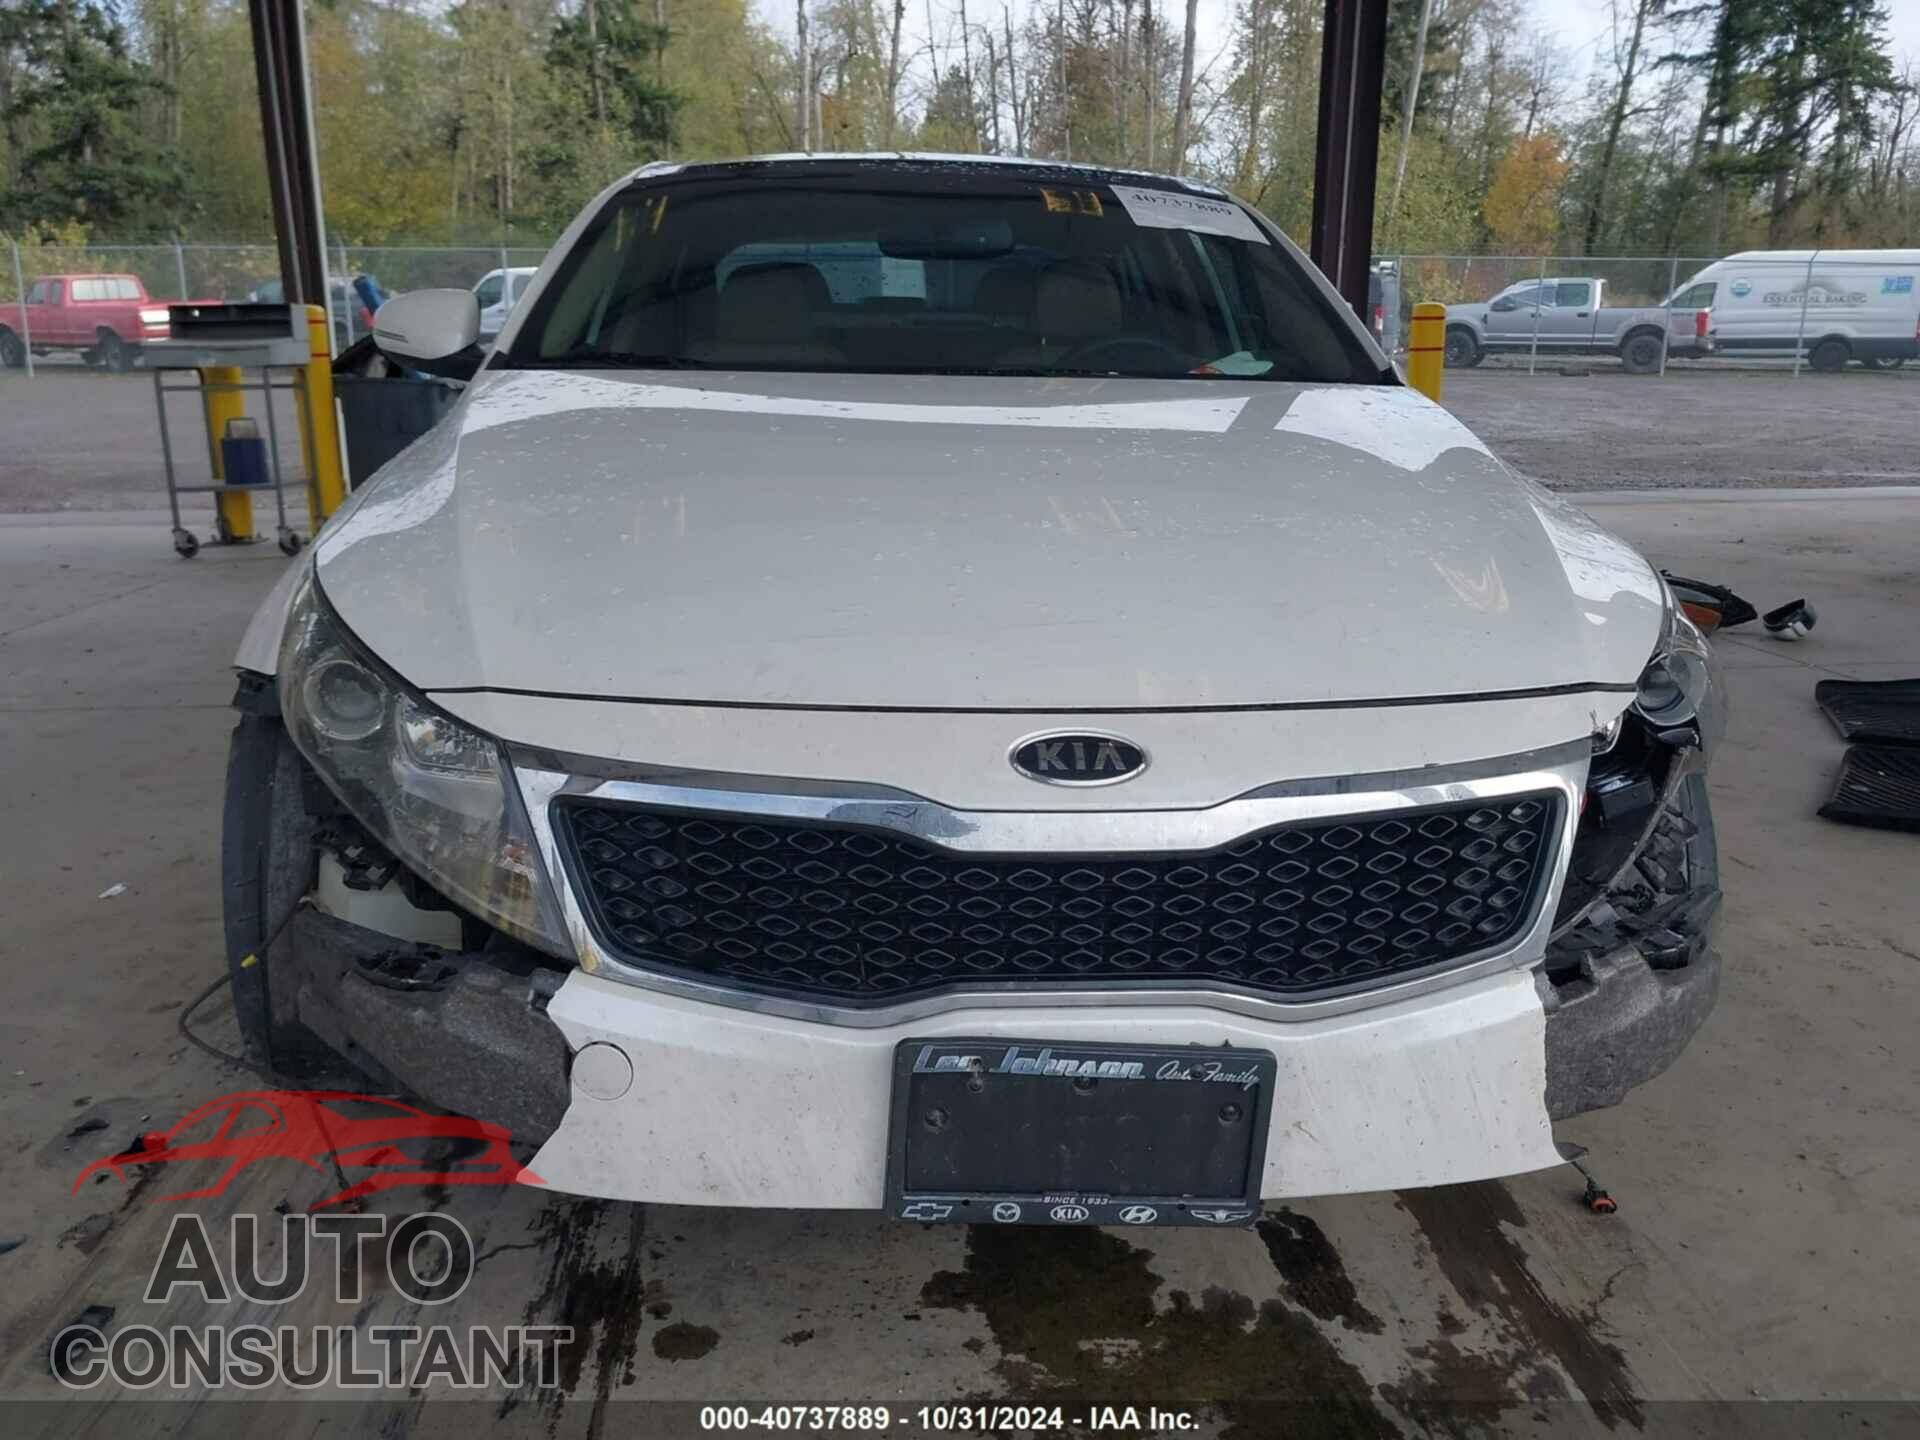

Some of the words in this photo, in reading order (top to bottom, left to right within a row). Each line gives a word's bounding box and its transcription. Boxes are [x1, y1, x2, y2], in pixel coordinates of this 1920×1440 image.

[1035, 742, 1127, 771] KIA
[1155, 1060, 1202, 1082] Aut
[1203, 1062, 1260, 1091] Family
[1056, 1208, 1083, 1220] KIA
